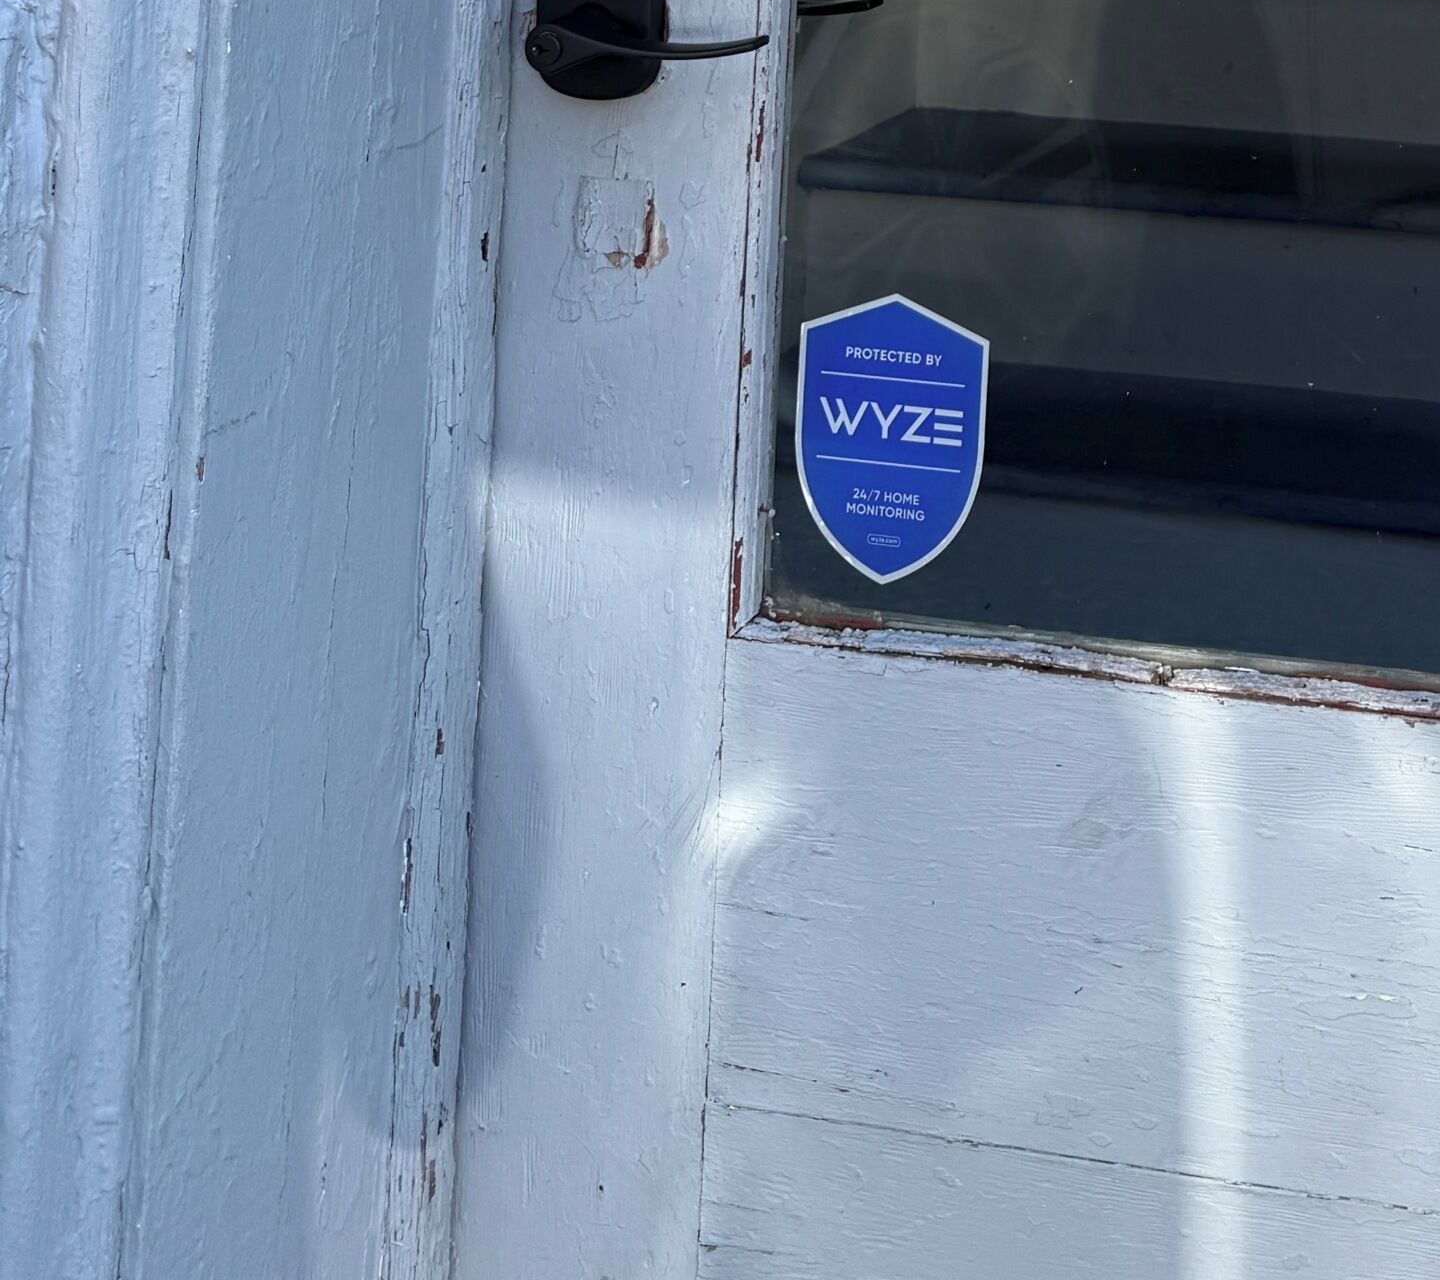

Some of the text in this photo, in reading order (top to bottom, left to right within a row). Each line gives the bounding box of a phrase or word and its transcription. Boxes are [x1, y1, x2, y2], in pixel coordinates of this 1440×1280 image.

[845, 345, 942, 366] PROTECTED BY
[819, 396, 964, 447] WYZE
[853, 488, 920, 505] 24/7 HOME
[846, 503, 925, 521] MONITORING
